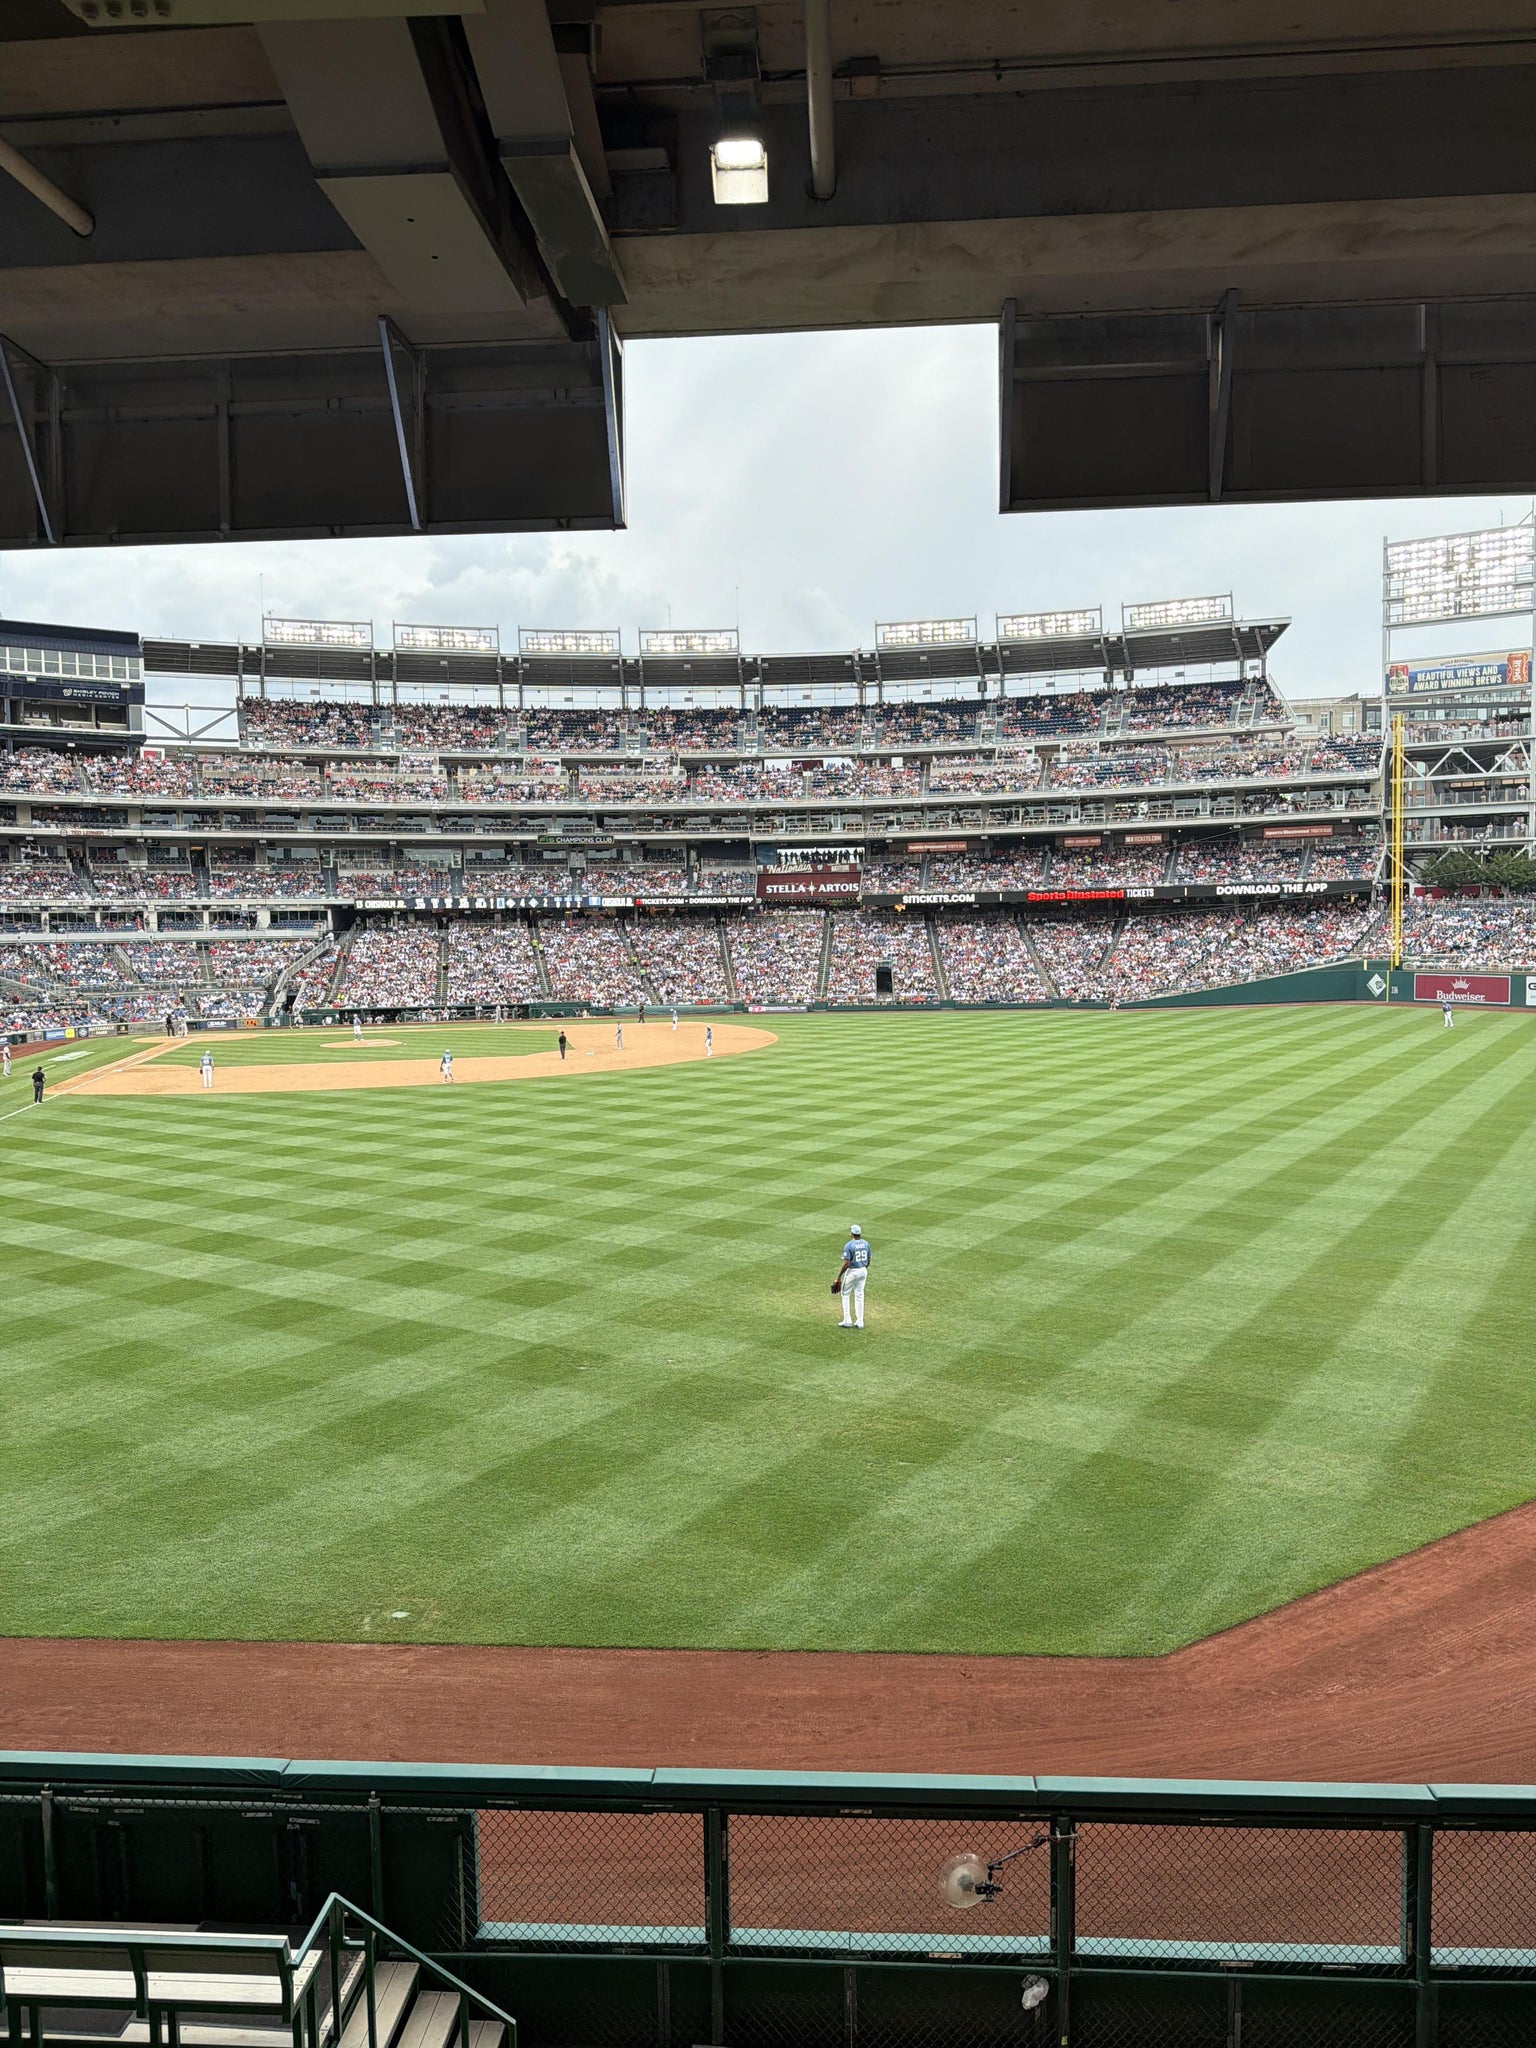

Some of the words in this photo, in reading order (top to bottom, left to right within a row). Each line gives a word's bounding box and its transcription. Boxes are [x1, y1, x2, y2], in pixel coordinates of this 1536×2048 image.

[1417, 670, 1455, 682] BEAUTIFUL
[1456, 667, 1481, 678] VIEWS
[1482, 665, 1498, 675] AND
[1413, 680, 1439, 691] AWARD
[1440, 677, 1475, 689] WINNING
[1475, 674, 1502, 686] BREWS
[766, 863, 813, 873] Nationals
[766, 884, 806, 894] STELLA
[818, 883, 859, 892] ARTOIS
[1216, 884, 1281, 895] DOWNLOAD
[1282, 884, 1304, 893] THE
[1305, 883, 1328, 892] APP
[902, 894, 975, 904] SITICKETS.COM
[1027, 891, 1066, 902] Sports
[1066, 890, 1124, 900] Illustrated
[1126, 888, 1155, 898] TICKETS
[364, 900, 396, 908] CHISHOLM
[1436, 990, 1485, 1001] Budweiser
[855, 1250, 868, 1262] 29
